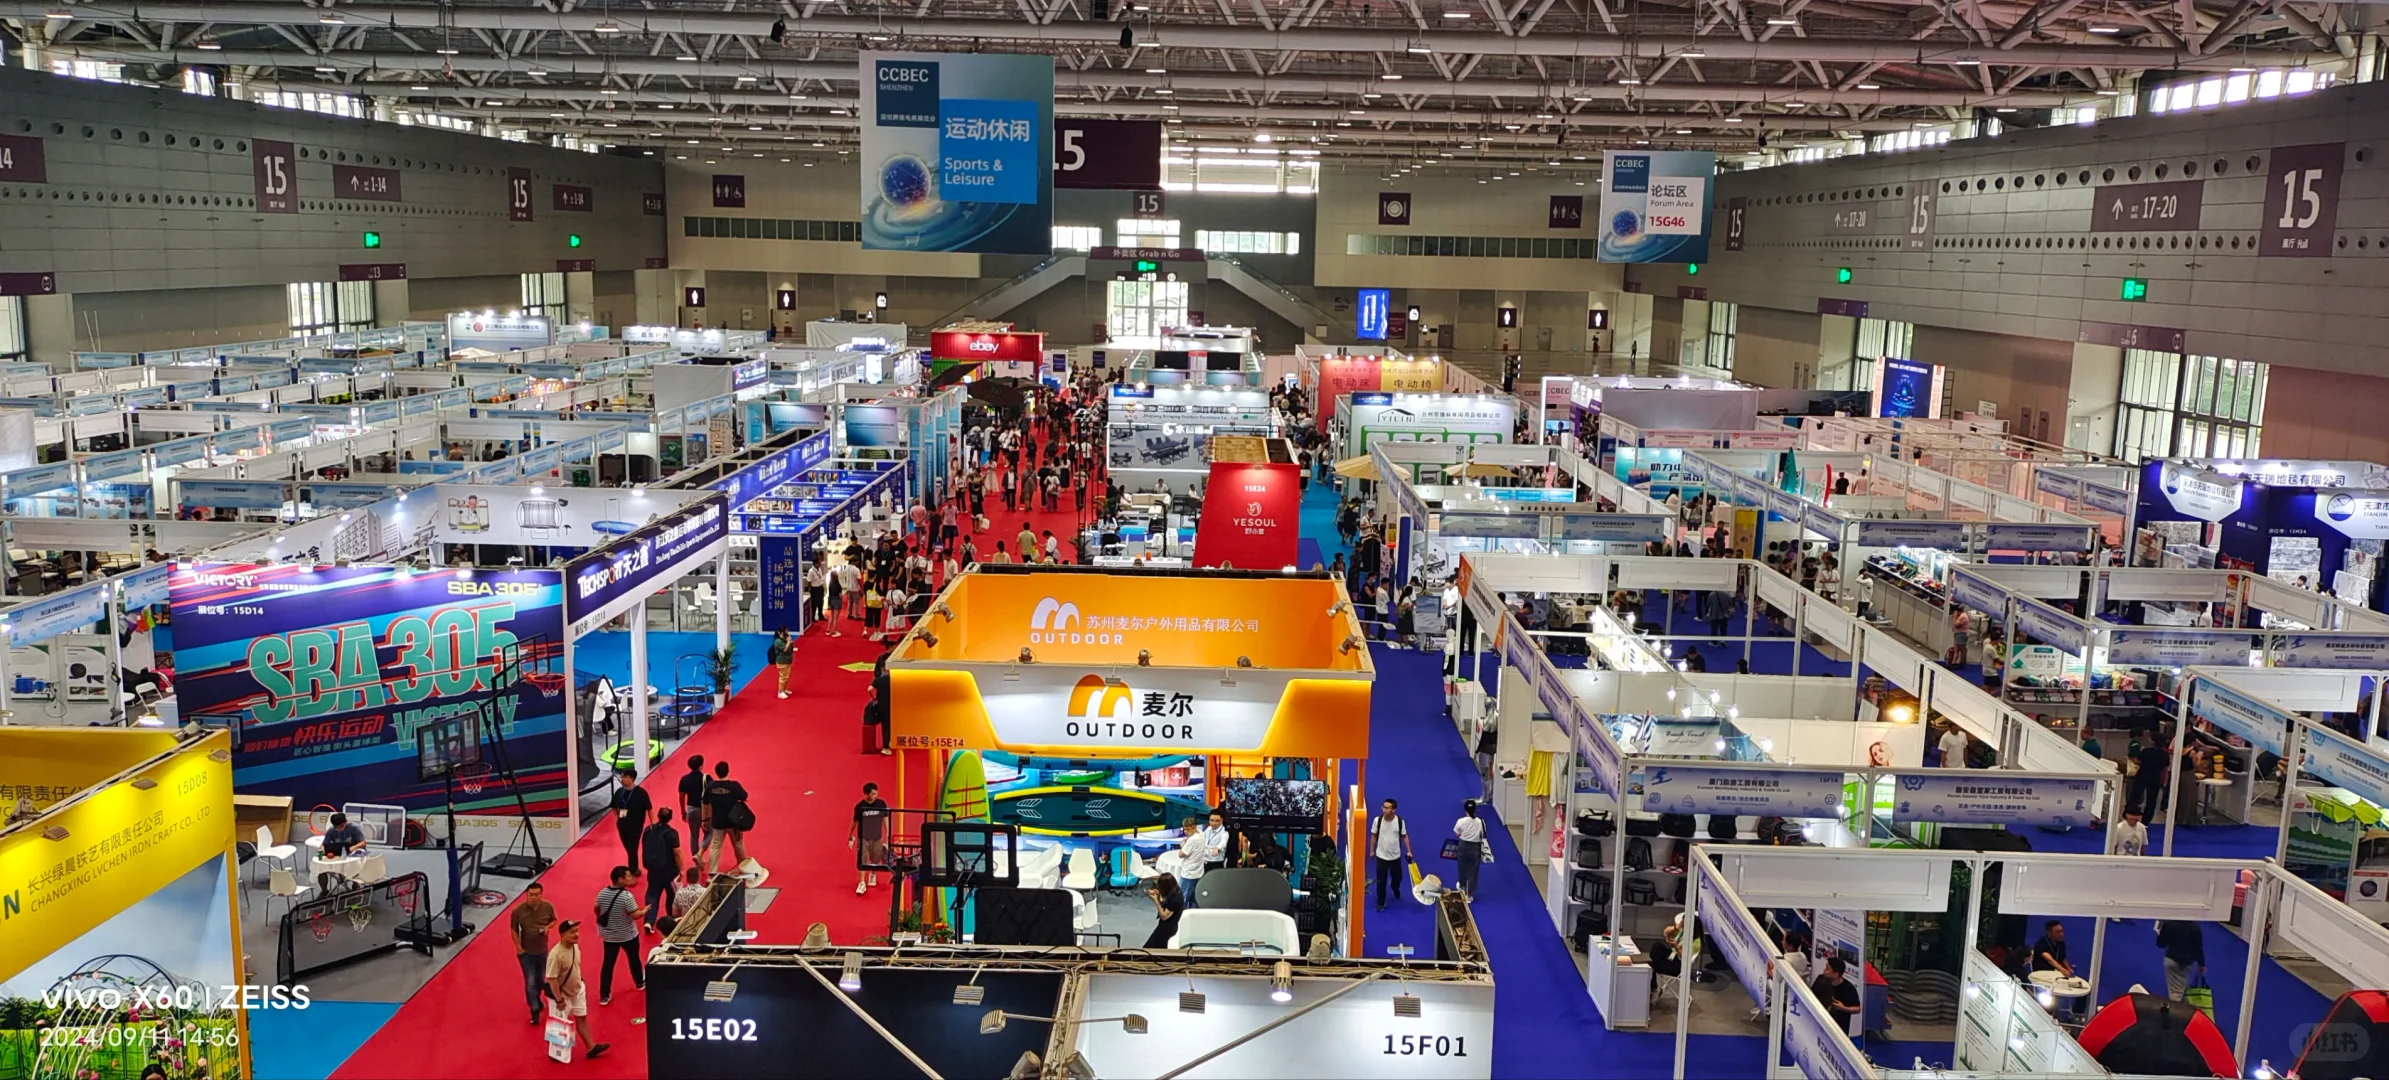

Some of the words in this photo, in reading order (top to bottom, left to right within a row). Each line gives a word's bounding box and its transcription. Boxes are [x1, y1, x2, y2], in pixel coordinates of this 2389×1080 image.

[879, 67, 929, 82] CCBEC
[879, 83, 914, 92] SHENZHEN
[945, 117, 1031, 142] 运动休闲
[1054, 129, 1086, 171] 5
[945, 157, 989, 172] Sports
[993, 159, 1003, 171] &
[1616, 159, 1644, 168] CCBEC
[263, 155, 287, 195] 15
[371, 176, 387, 193] 1-14
[945, 172, 995, 186] Leisure
[513, 179, 528, 208] 15
[1651, 184, 1687, 198] 论坛区
[2279, 168, 2323, 229] 15
[1139, 194, 1159, 213] 15
[1676, 200, 1694, 208] Area
[2142, 194, 2177, 219] 17-20
[1650, 216, 1685, 227] 15G46
[1730, 209, 1742, 238] 15
[1849, 211, 1866, 228] 17-20
[1910, 195, 1929, 234] 15
[1113, 249, 1138, 258] 外卖区
[1139, 249, 1160, 258] Grab
[1168, 250, 1180, 258] Go
[969, 340, 999, 353] ebay
[2131, 329, 2138, 346] 6
[1394, 379, 1431, 389] 电动椅
[1233, 518, 1277, 527] YESOUL
[622, 543, 649, 578] 天之鑫
[193, 573, 254, 587] VICTORY
[233, 606, 264, 615] 15D14
[1085, 614, 1259, 634] 苏州麦尔户外用品有限公司
[1030, 632, 1124, 645] OUTDOOR
[248, 622, 388, 725] SBA
[1142, 691, 1194, 718] 麦尔
[293, 714, 386, 746] 快乐运动
[1066, 721, 1194, 740] OUTDOOR
[176, 770, 208, 797] 15D08
[27, 809, 164, 896] 长兴绿晨铁艺有限责任公司
[30, 870, 91, 912] CHANGXING
[93, 851, 128, 879] LVCHEN
[129, 840, 151, 858] IRON
[152, 823, 178, 845] CRAFT
[196, 805, 211, 821] LTD
[671, 1018, 758, 1041] 15E02
[1383, 1034, 1467, 1057] 15F01
